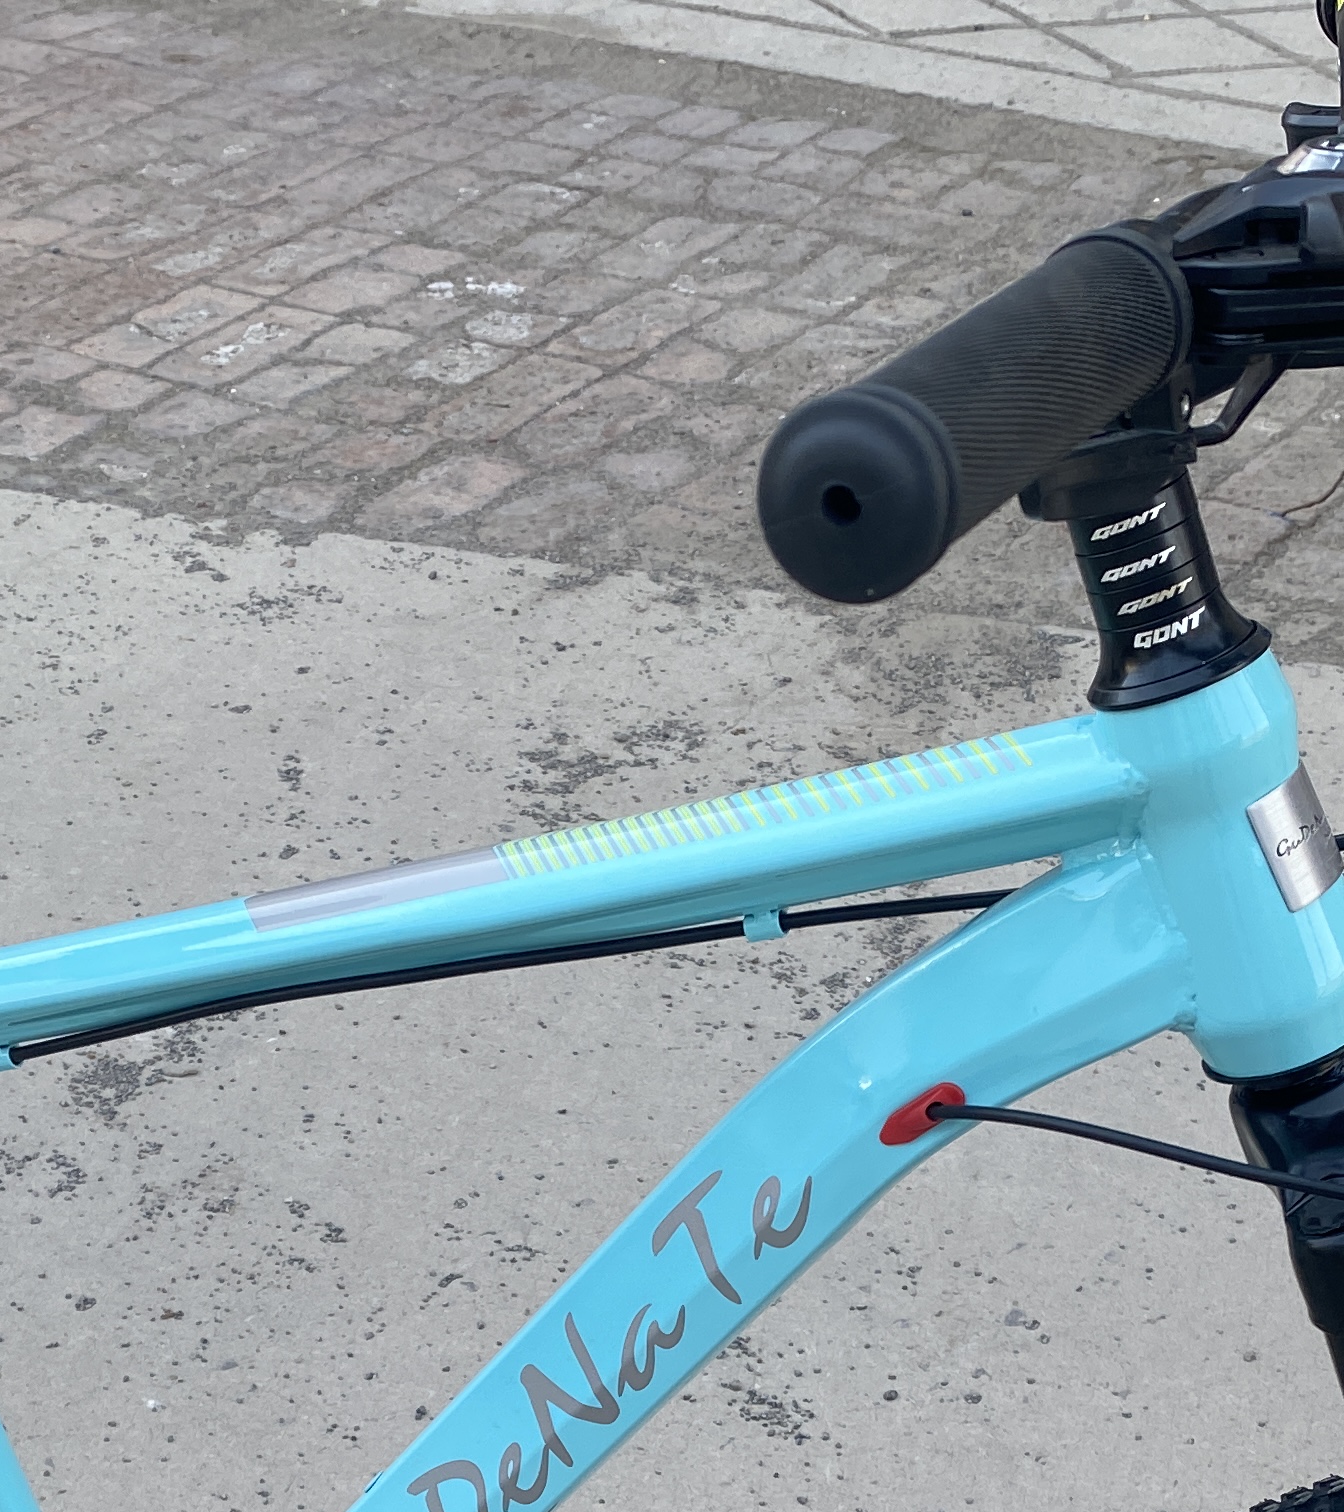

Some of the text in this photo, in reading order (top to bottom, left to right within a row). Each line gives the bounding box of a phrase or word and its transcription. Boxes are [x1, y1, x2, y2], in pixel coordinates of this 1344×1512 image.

[1090, 501, 1167, 542] GONT
[1100, 545, 1177, 583] GONT
[1116, 576, 1193, 617] GONT
[1133, 605, 1206, 649] GONT
